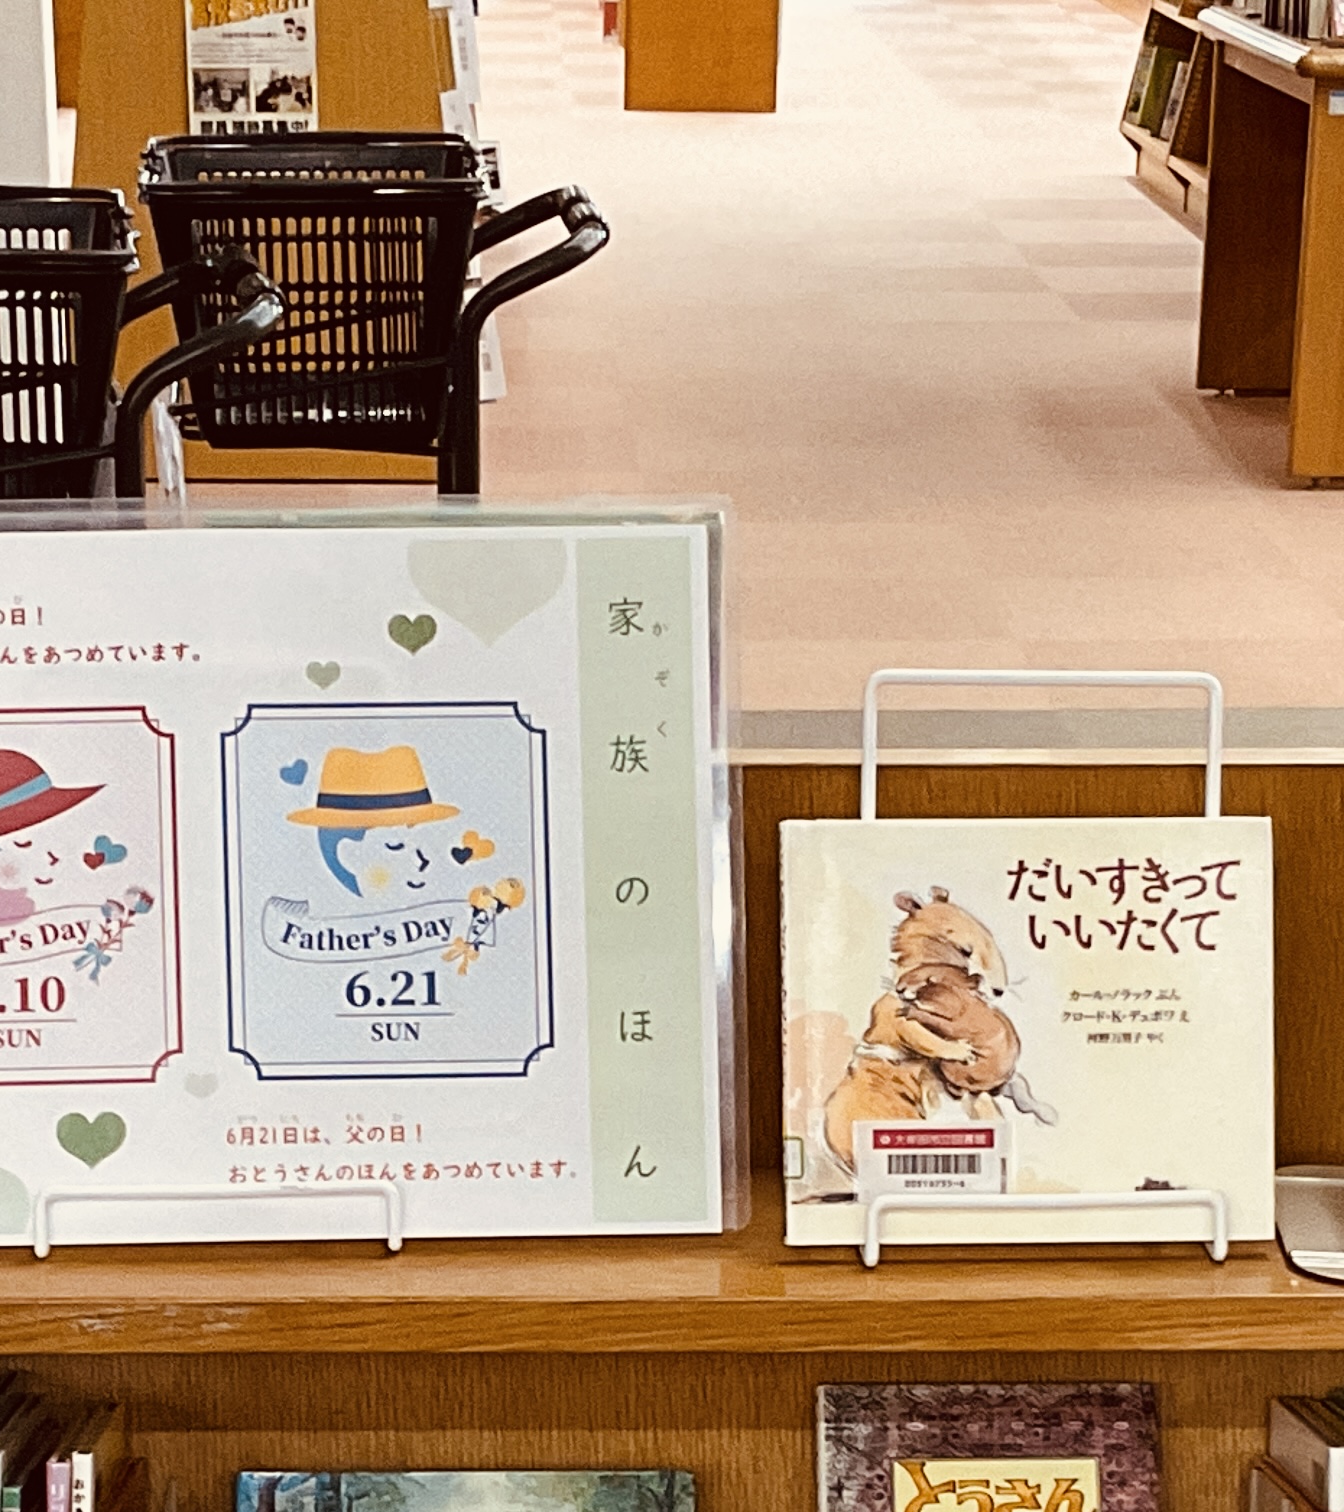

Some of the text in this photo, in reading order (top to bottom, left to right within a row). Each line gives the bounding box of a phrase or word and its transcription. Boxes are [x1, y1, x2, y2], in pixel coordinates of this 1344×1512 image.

[1006, 856, 1242, 906] だいすきって
[40, 918, 92, 948] Day
[404, 914, 456, 944] Day
[1027, 908, 1222, 955] いいたくて
[344, 969, 442, 1010] 6.21
[369, 1021, 421, 1042] SUN
[228, 1157, 577, 1184] おとうさんのほんをあつめています。
